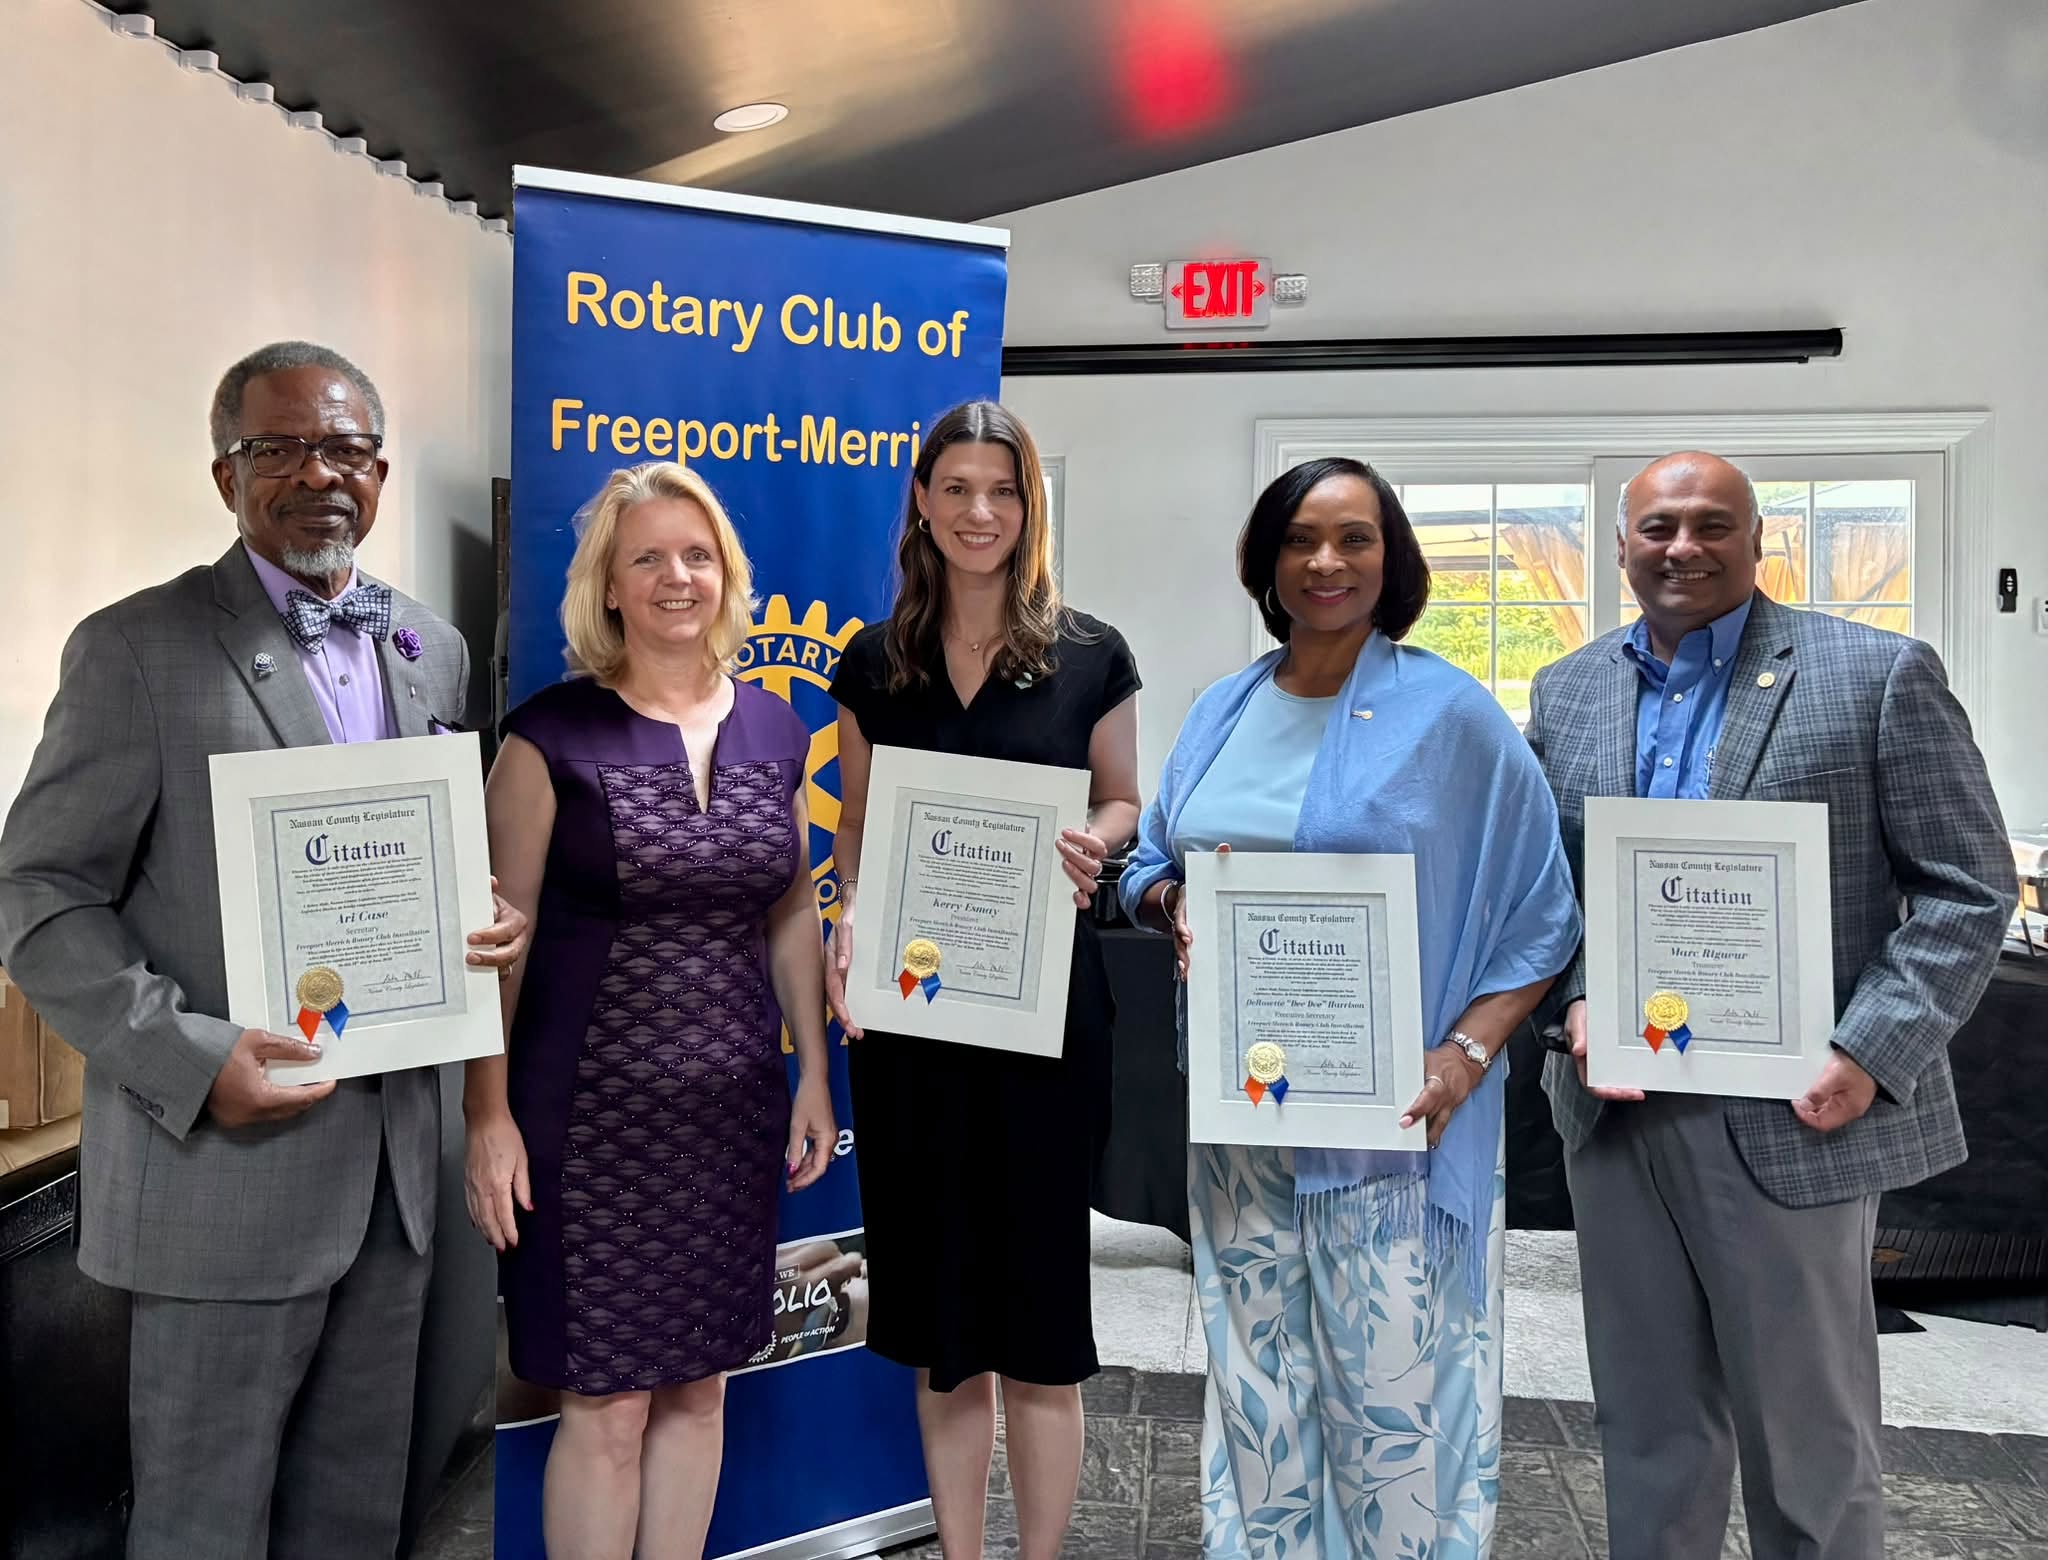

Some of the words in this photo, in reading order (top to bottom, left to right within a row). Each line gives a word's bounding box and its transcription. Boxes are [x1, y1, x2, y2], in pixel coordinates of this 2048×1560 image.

[1183, 261, 1258, 318] EXIT
[567, 271, 763, 353] Rotary
[781, 294, 901, 352] Club
[917, 310, 969, 357] of
[551, 398, 920, 468] Freeport-Merri
[734, 636, 840, 675] OTARY
[326, 814, 360, 827] County
[362, 809, 416, 822] Legislature
[952, 816, 980, 828] County
[982, 820, 1026, 833] Legislature
[305, 833, 407, 866] Citation
[931, 829, 1012, 864] Citation
[1680, 861, 1712, 872] County
[1714, 861, 1763, 873] Legislature
[1661, 875, 1752, 905] Citation
[933, 898, 963, 914] Kerry
[358, 910, 389, 922] Case
[1277, 913, 1307, 924] County
[1309, 914, 1356, 924] Legislature
[345, 926, 379, 935] Secretary
[1259, 928, 1346, 956] Citation
[1671, 947, 1700, 958] Marc
[779, 1269, 795, 1279] WE
[773, 1278, 831, 1315] OLIO
[781, 1331, 803, 1344] PEOPLE
[810, 1325, 835, 1336] ACTION
